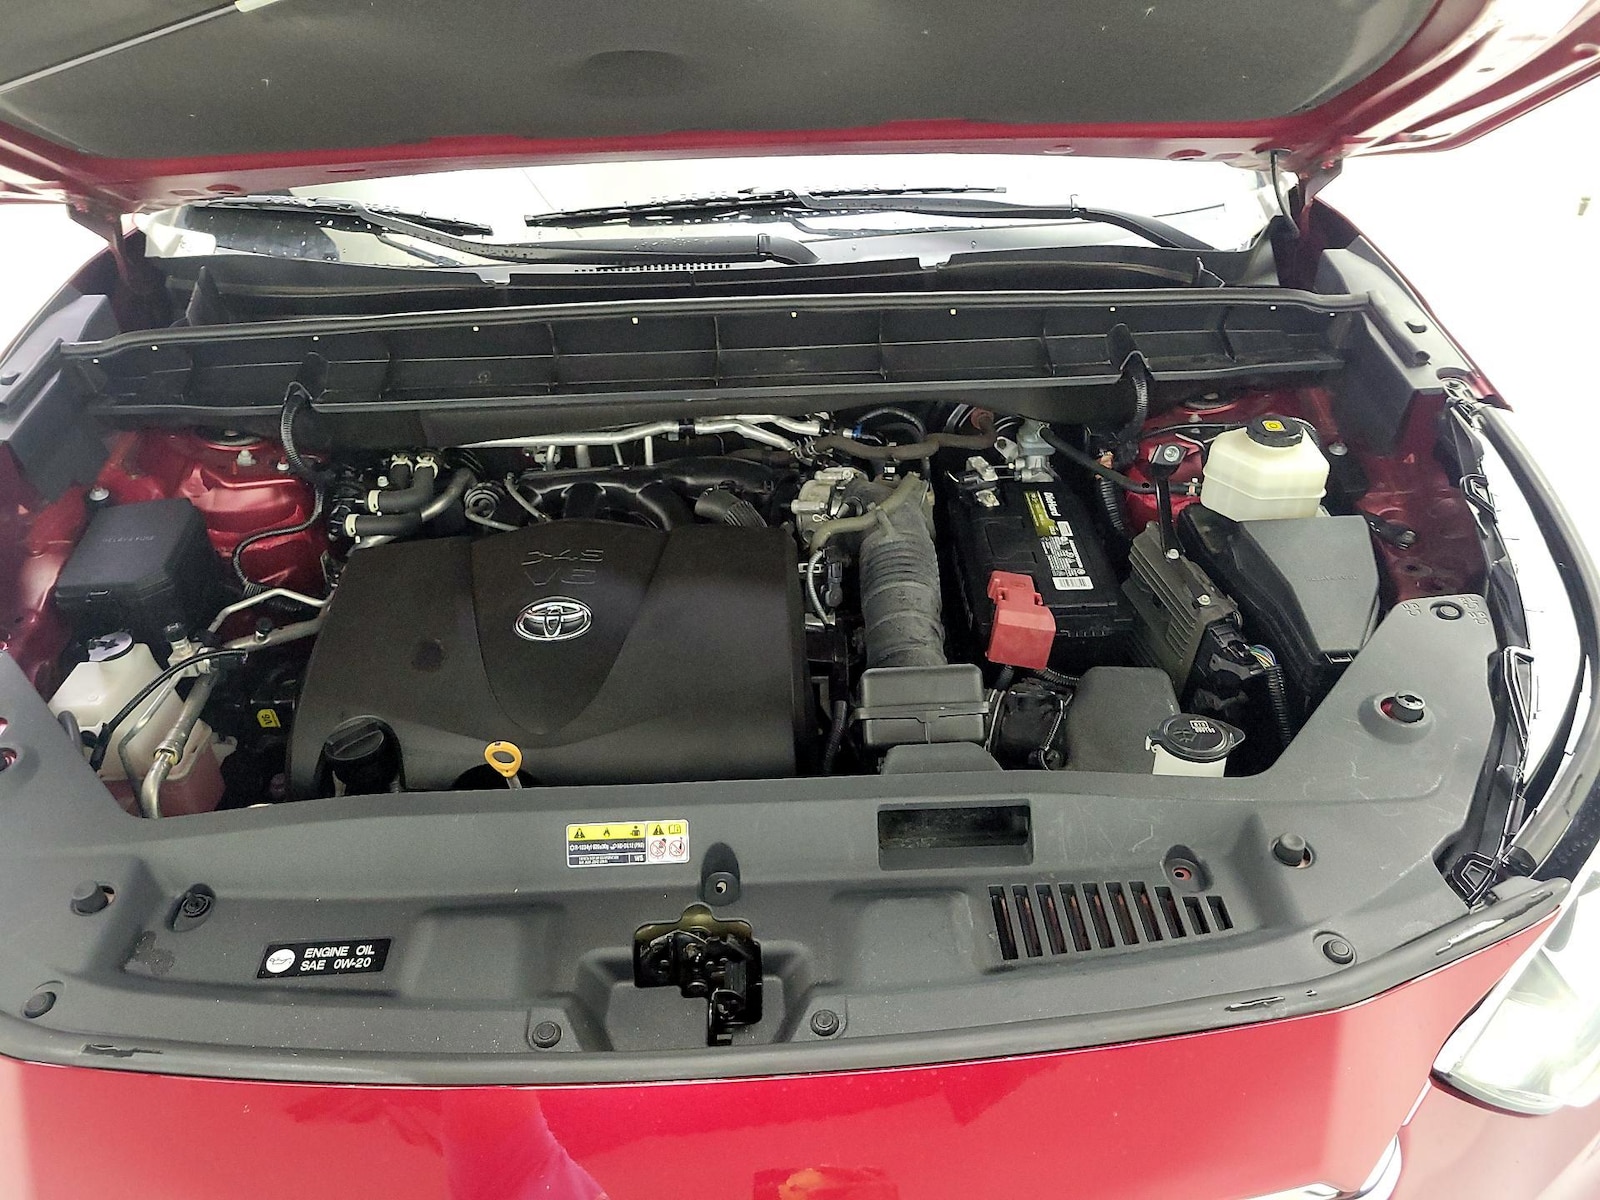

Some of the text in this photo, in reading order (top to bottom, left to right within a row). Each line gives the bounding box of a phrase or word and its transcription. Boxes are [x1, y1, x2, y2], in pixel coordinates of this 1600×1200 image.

[303, 944, 376, 959] ENGINE OIL
[300, 957, 372, 972] SAE 0W-20
